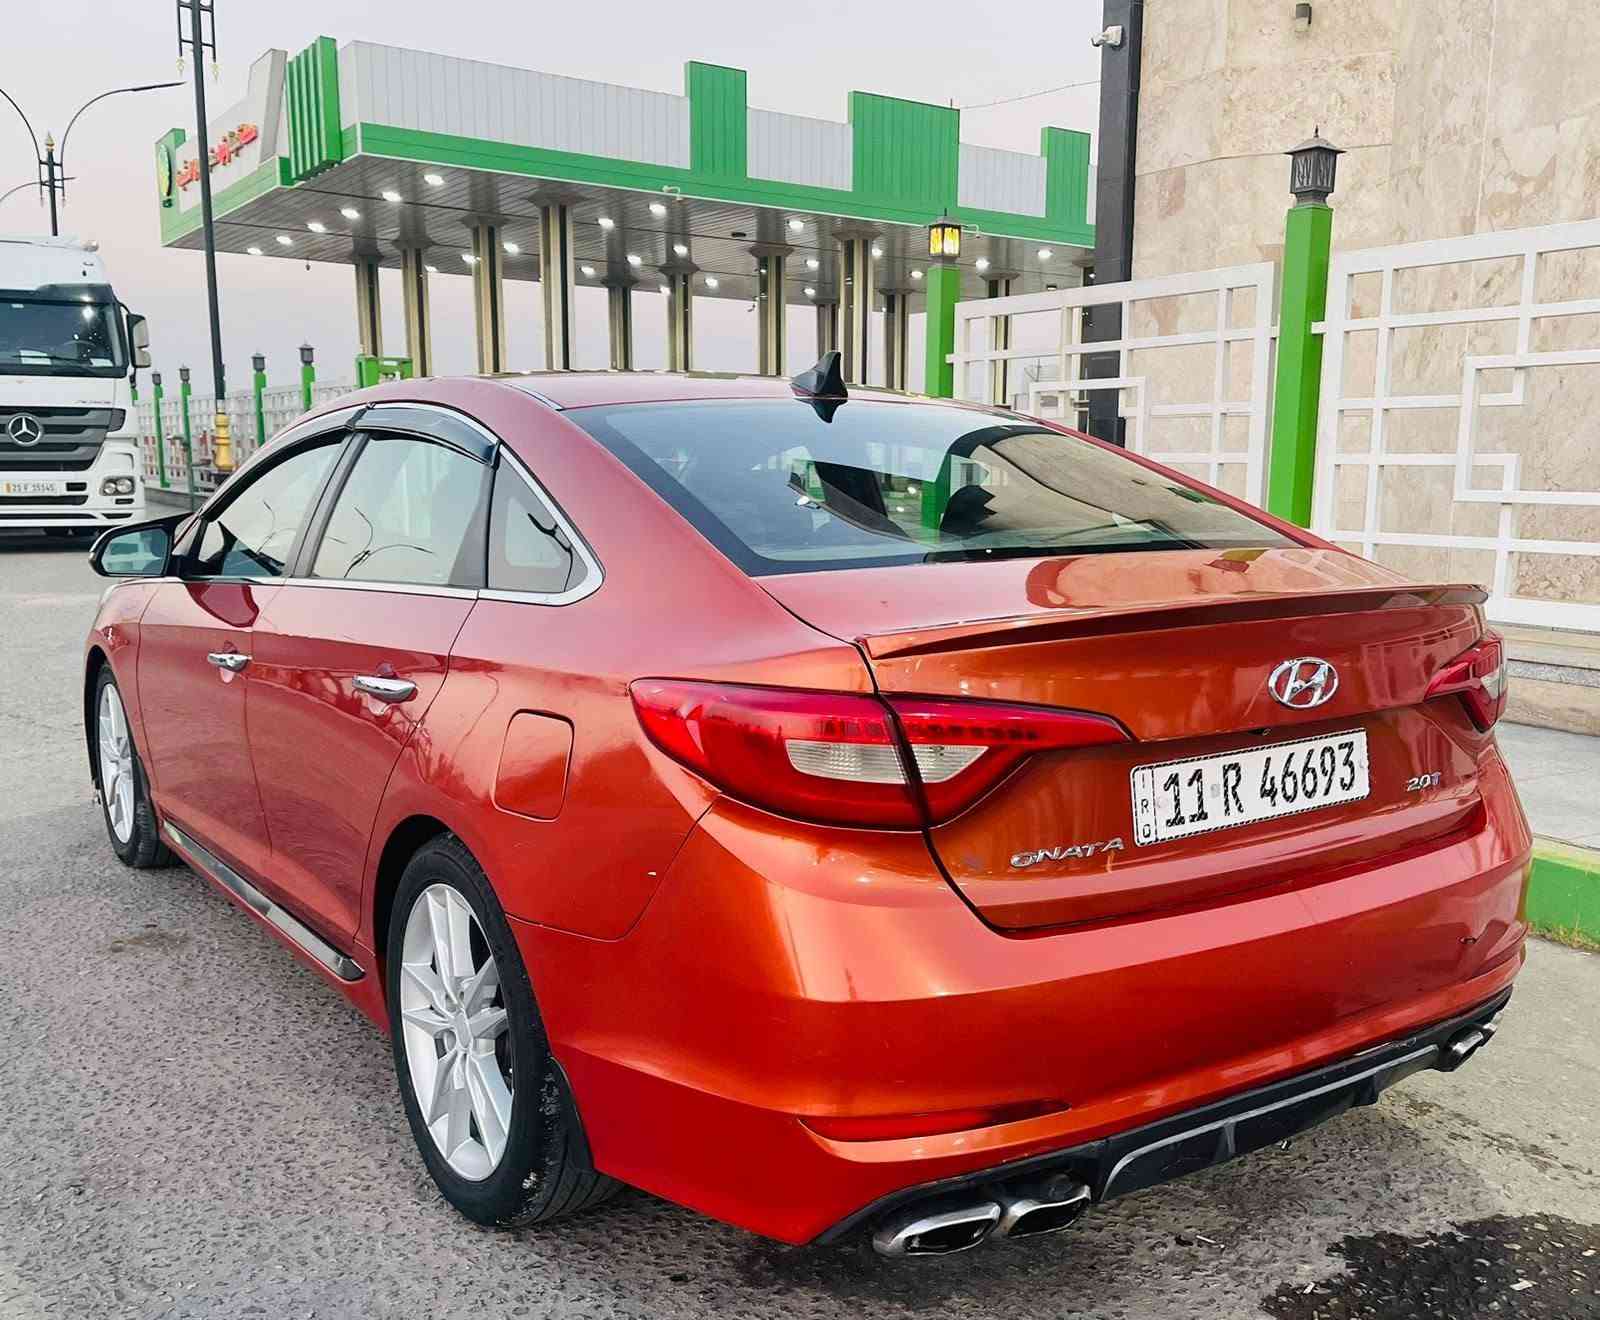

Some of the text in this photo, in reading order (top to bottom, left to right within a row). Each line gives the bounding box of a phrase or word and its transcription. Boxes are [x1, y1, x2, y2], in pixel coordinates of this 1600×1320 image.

[1163, 741, 1356, 828] 11 R 46693
